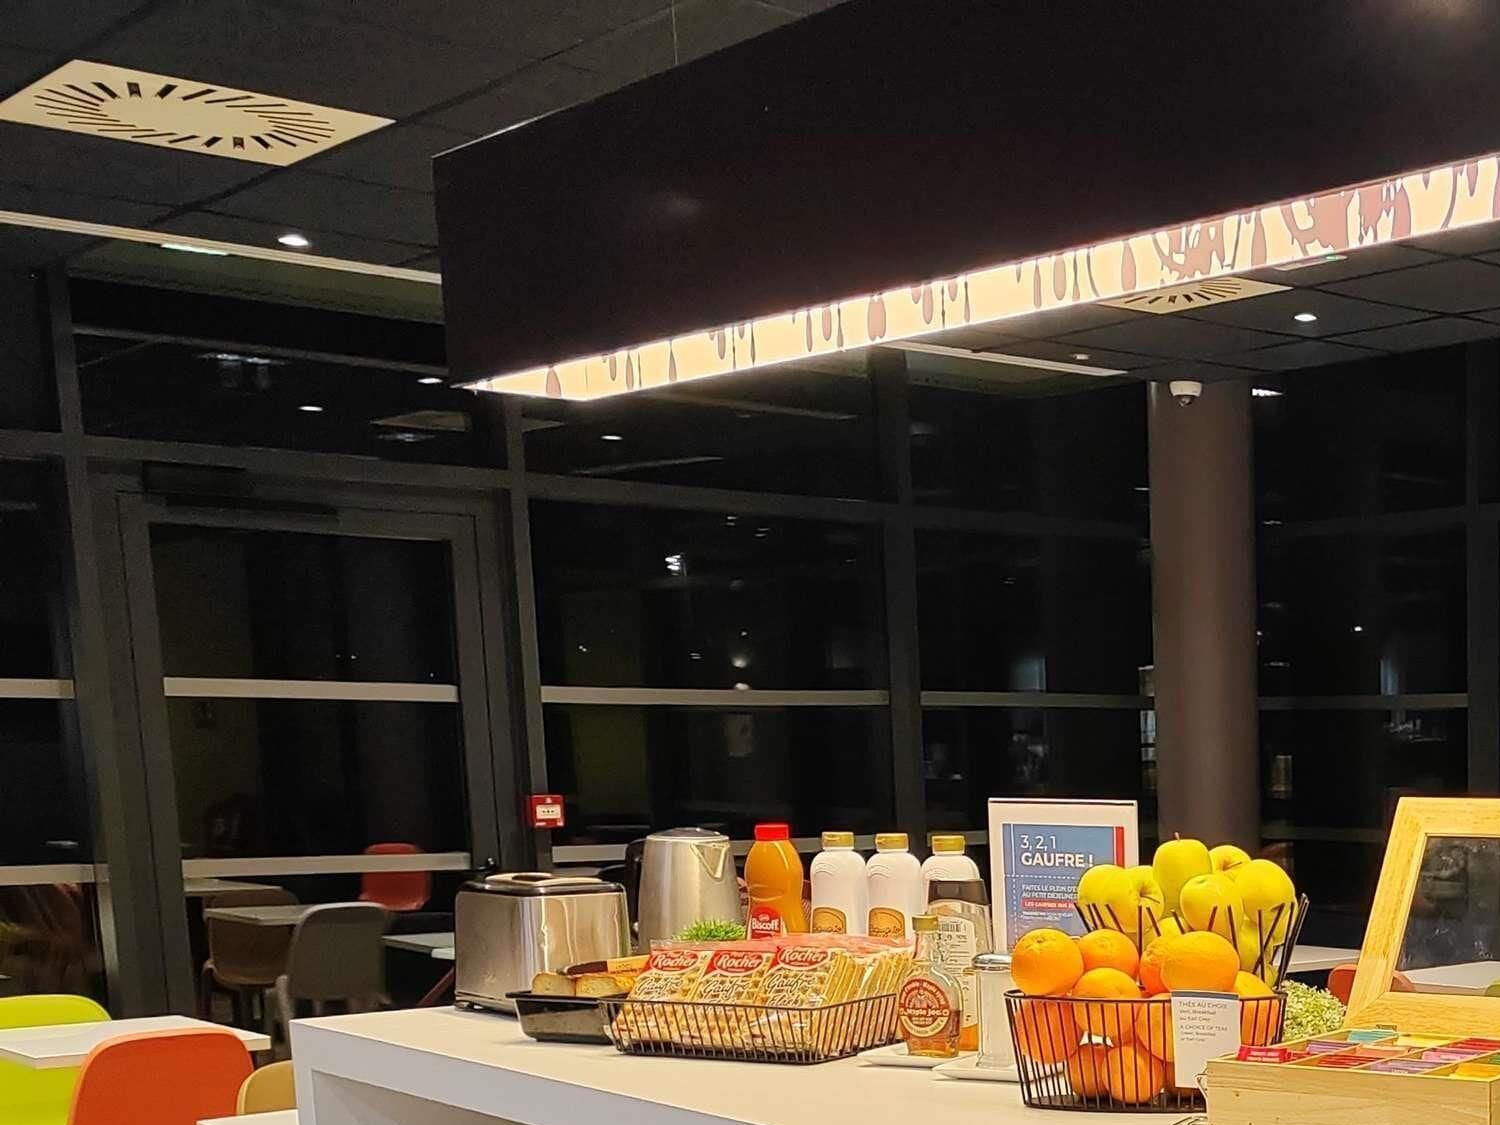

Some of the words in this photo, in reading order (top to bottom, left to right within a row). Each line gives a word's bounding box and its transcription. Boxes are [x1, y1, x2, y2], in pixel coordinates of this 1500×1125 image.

[1020, 835, 1033, 851] 3,
[1036, 836, 1047, 851] 2,
[1050, 836, 1056, 849] 1
[1021, 852, 1085, 868] GAUFRE
[653, 953, 695, 968] Rocher
[717, 954, 762, 969] Rocher
[781, 949, 826, 963] Rocher
